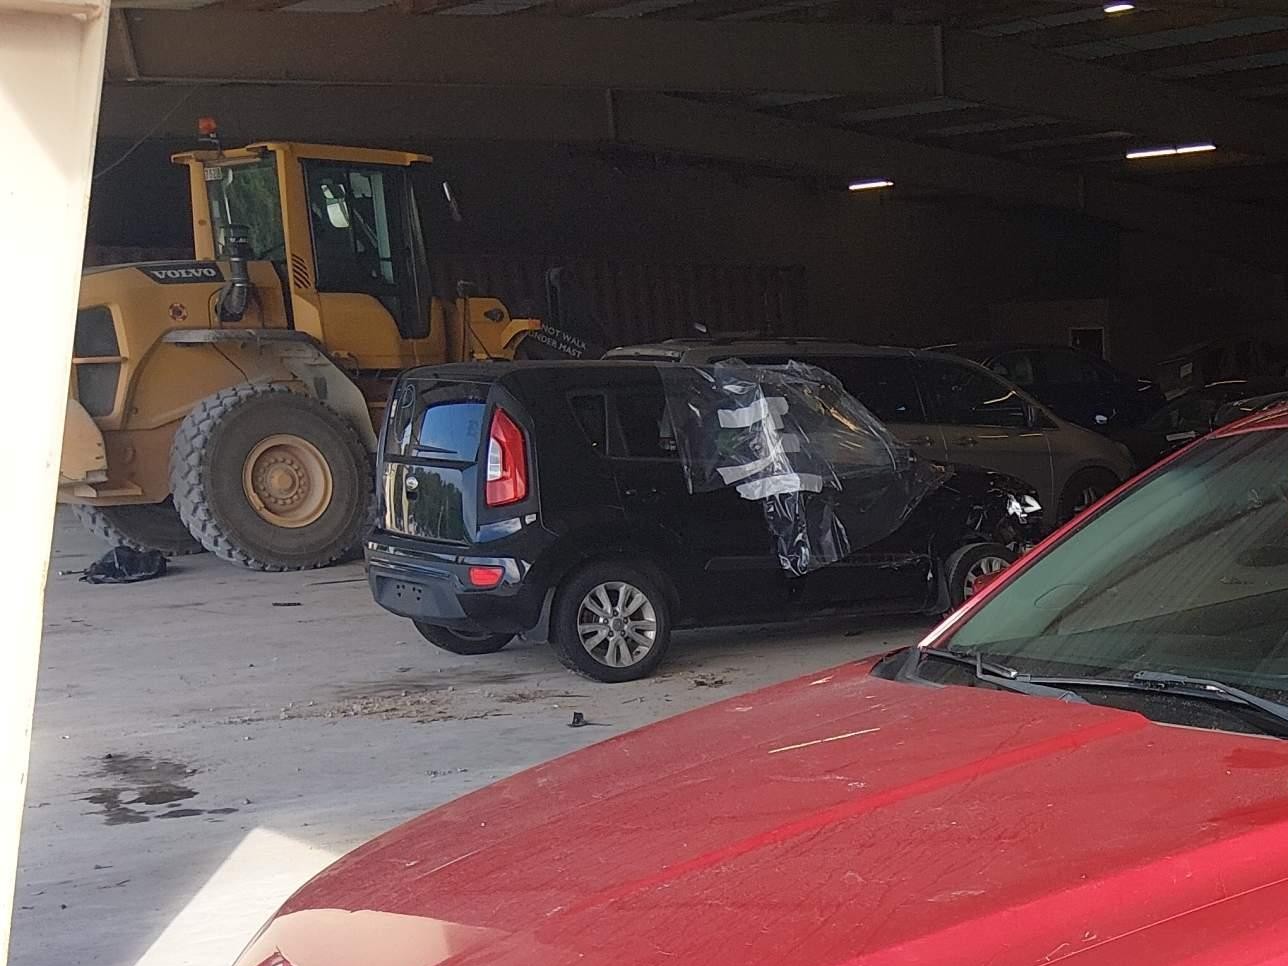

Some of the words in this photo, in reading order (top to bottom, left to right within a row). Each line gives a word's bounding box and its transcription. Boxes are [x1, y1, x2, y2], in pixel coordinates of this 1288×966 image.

[150, 268, 217, 279] VOLVO
[543, 323, 561, 338] NOT
[562, 331, 587, 351] WALK
[558, 343, 583, 358] MAST
